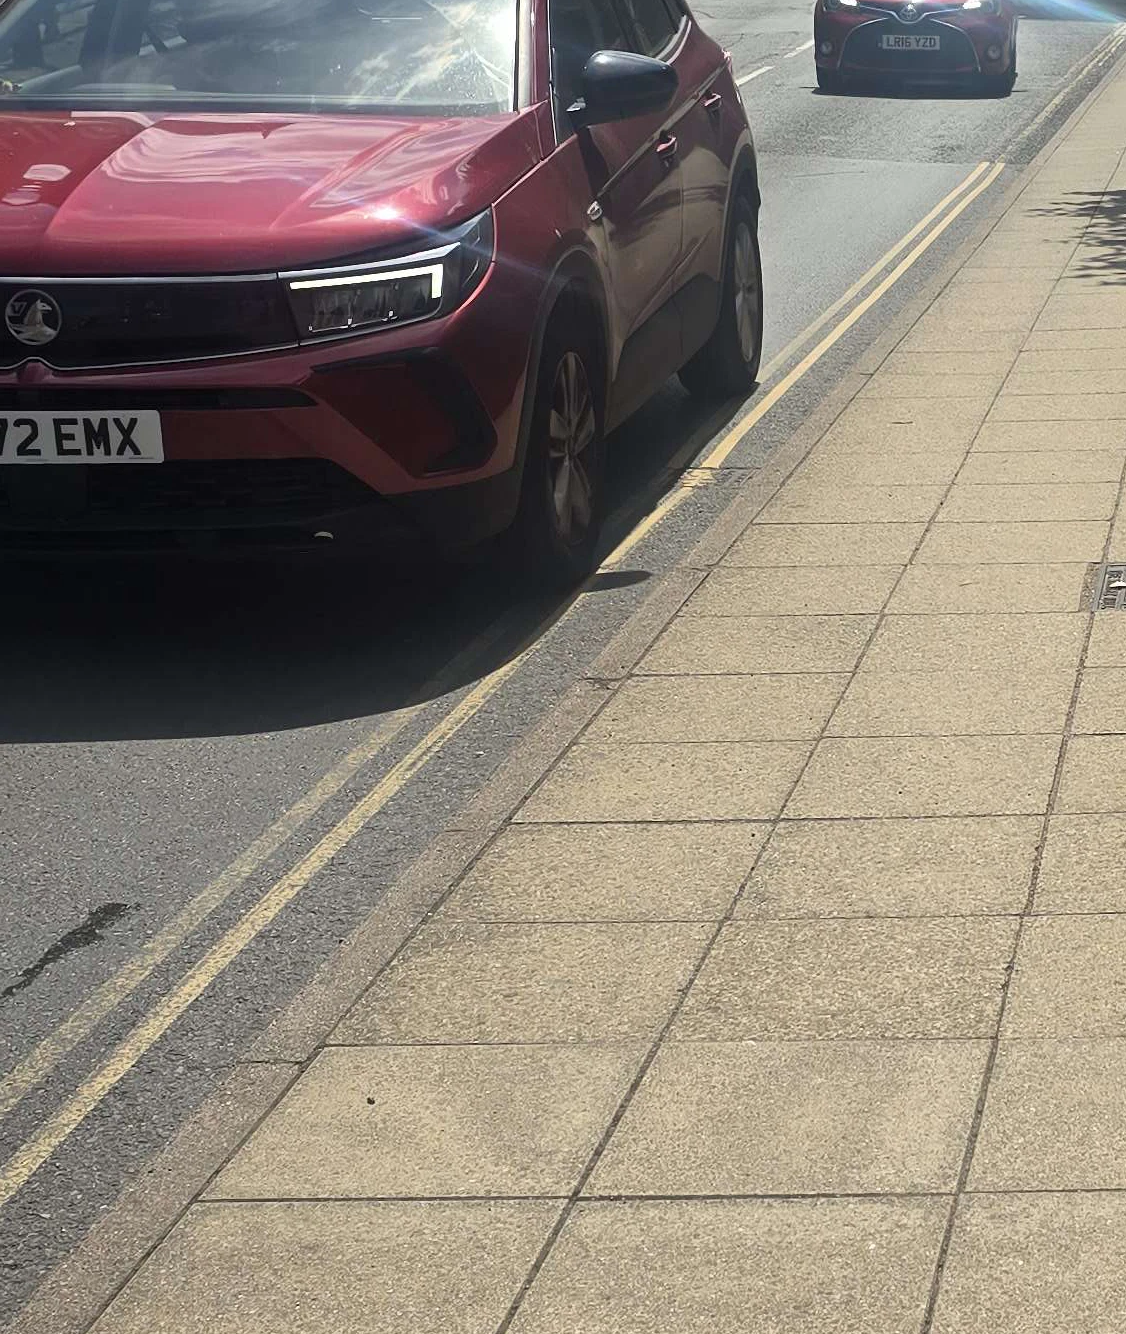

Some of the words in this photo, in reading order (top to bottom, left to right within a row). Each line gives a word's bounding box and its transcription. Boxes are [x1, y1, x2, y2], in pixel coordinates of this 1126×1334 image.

[886, 36, 911, 48] LR16
[915, 36, 936, 48] YZD
[52, 417, 142, 456] EMX
